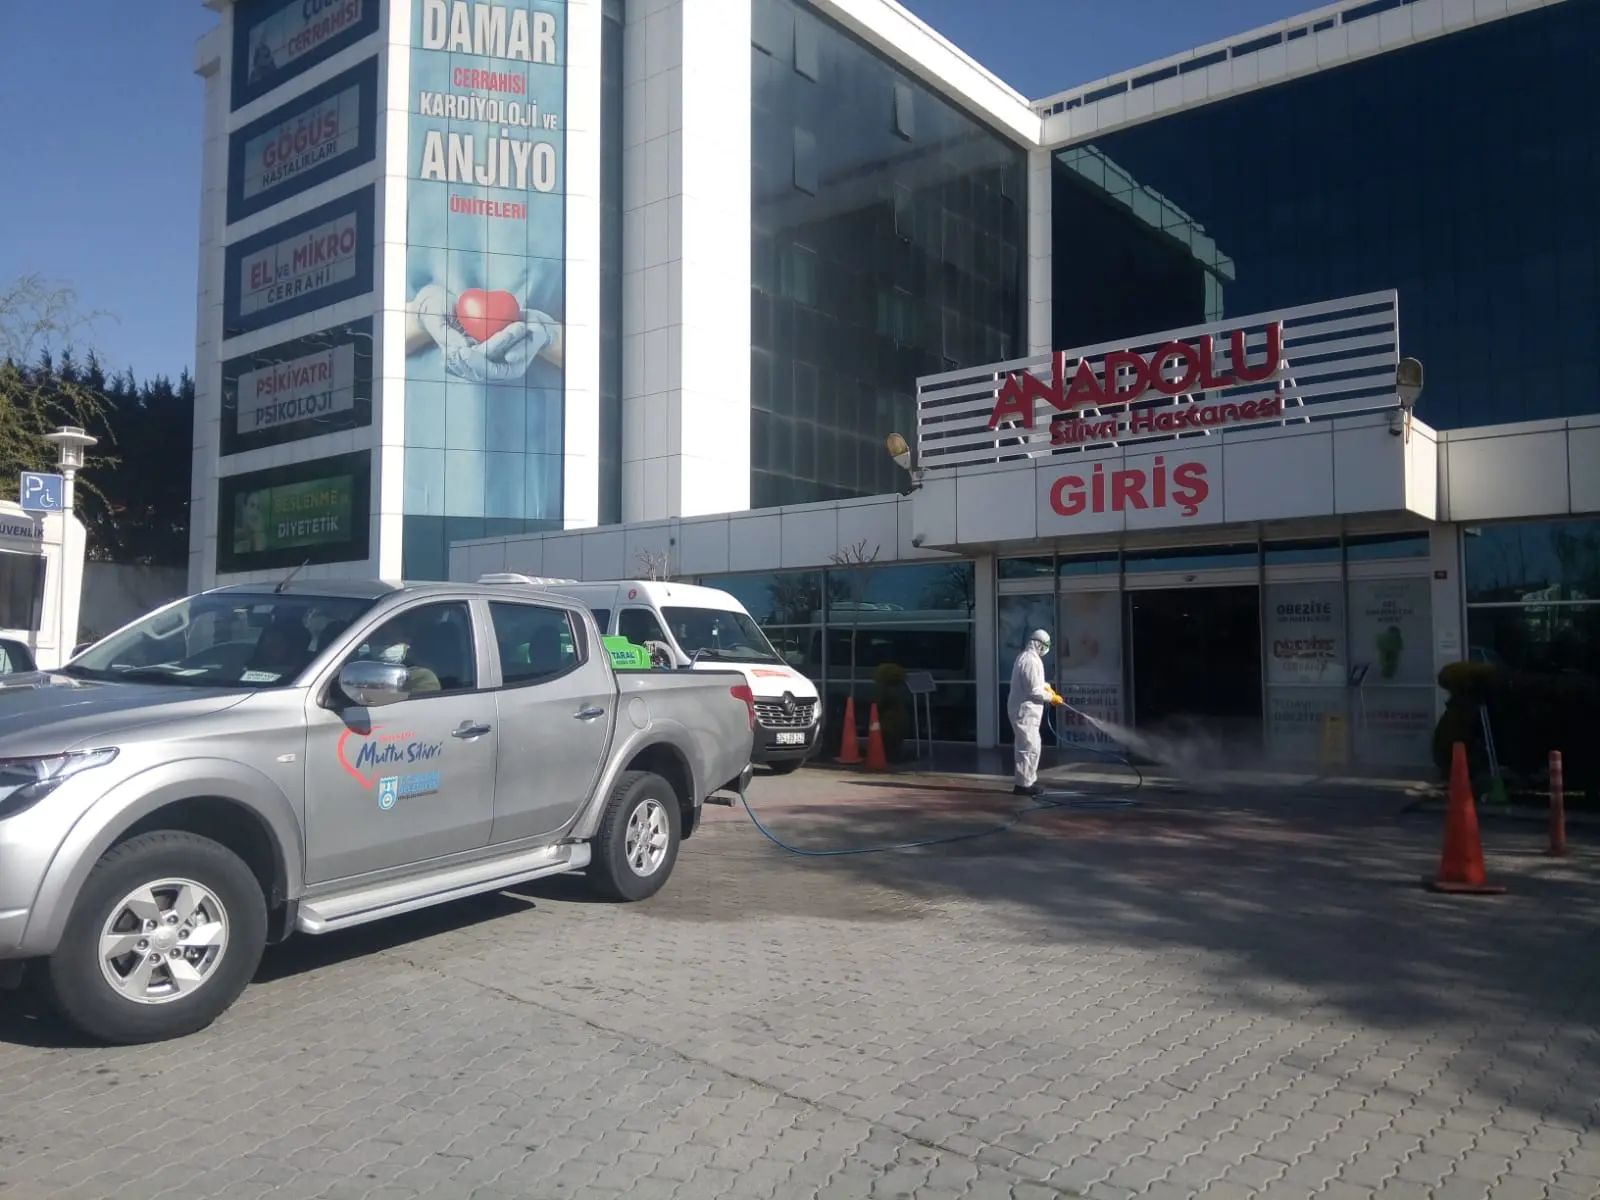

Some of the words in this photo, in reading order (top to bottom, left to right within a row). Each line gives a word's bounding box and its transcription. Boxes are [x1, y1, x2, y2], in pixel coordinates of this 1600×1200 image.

[422, 0, 557, 65] DAMAR
[453, 66, 527, 95] CERRAHİSİ
[420, 91, 538, 126] KARDİYOLOJİ
[543, 112, 557, 130] VE
[263, 108, 338, 169] GÖĞÜS
[420, 128, 557, 193] ANJİYO
[262, 140, 337, 188] HASTALIKLARI
[450, 193, 527, 221] ÜNİTELERİ
[250, 259, 273, 290] EL
[293, 227, 355, 274] MİKRO
[256, 352, 333, 398] PSİKİYATRİ
[988, 322, 1281, 429] ANADOLU
[255, 387, 333, 426] PSİKOLOJİ
[1050, 413, 1118, 446] Silivri
[1131, 388, 1283, 435] Hastanesi
[1050, 456, 1210, 518] GİRİŞ
[277, 510, 340, 539] DİYETETİK
[1276, 600, 1332, 615] OBEZİTE
